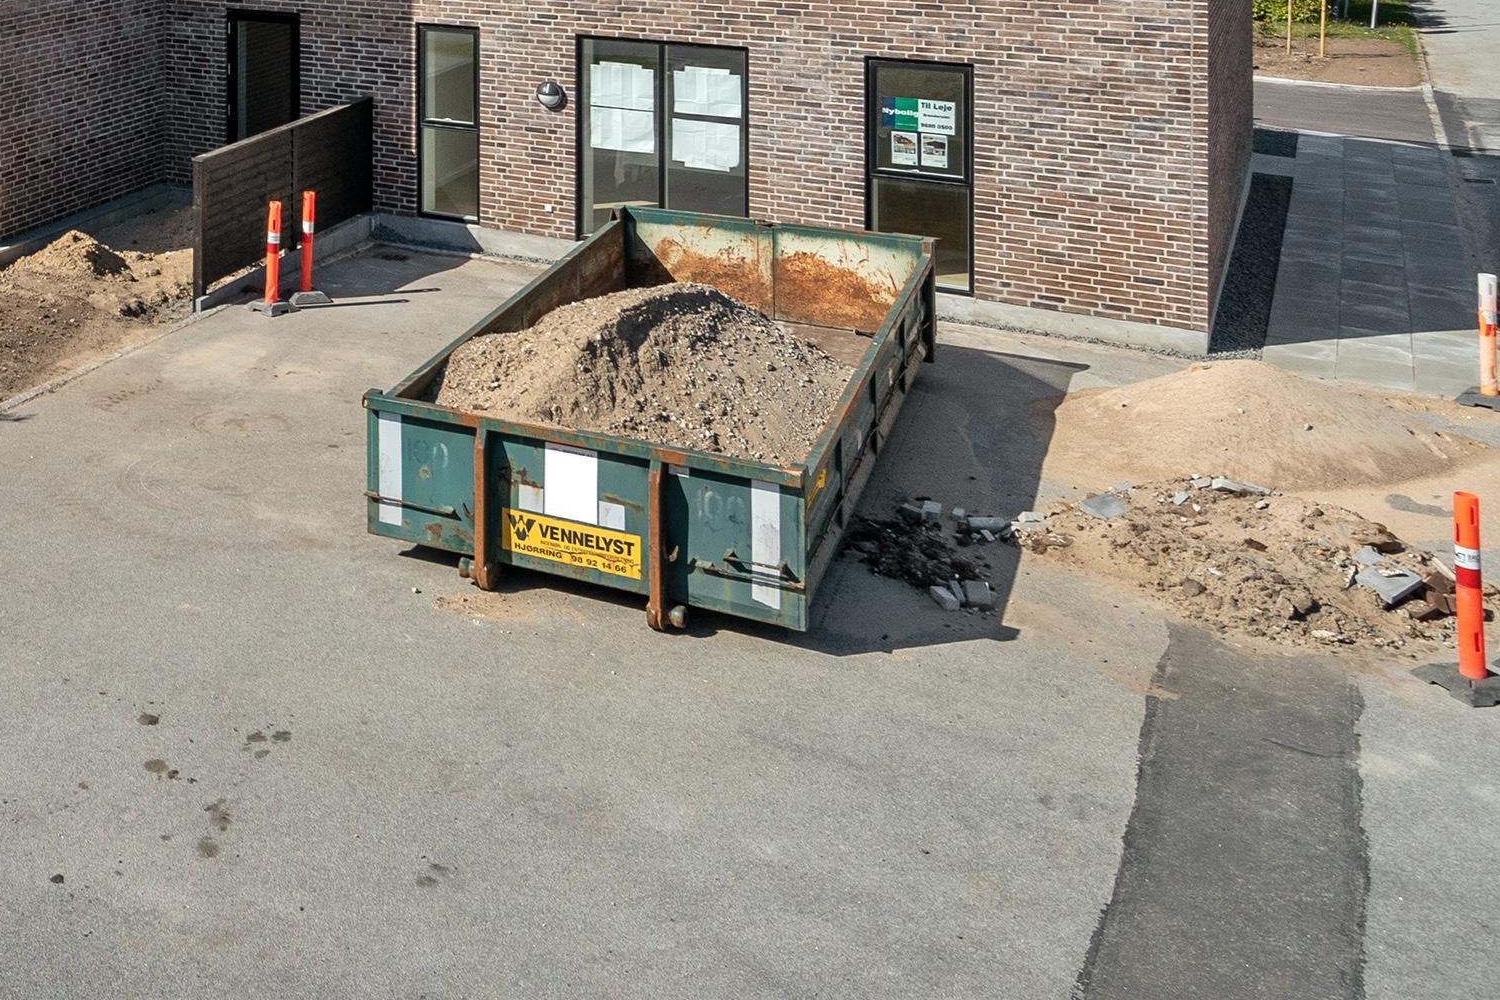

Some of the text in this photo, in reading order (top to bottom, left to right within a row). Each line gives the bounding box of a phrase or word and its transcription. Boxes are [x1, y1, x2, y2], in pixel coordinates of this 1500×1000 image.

[882, 107, 919, 118] Nybolig
[933, 103, 952, 112] Leje
[539, 523, 635, 557] VENNELYST
[514, 542, 563, 560] HJØRRING
[571, 555, 583, 564] 98
[586, 558, 598, 568] 92
[602, 562, 612, 570] 14
[615, 564, 627, 574] 66
